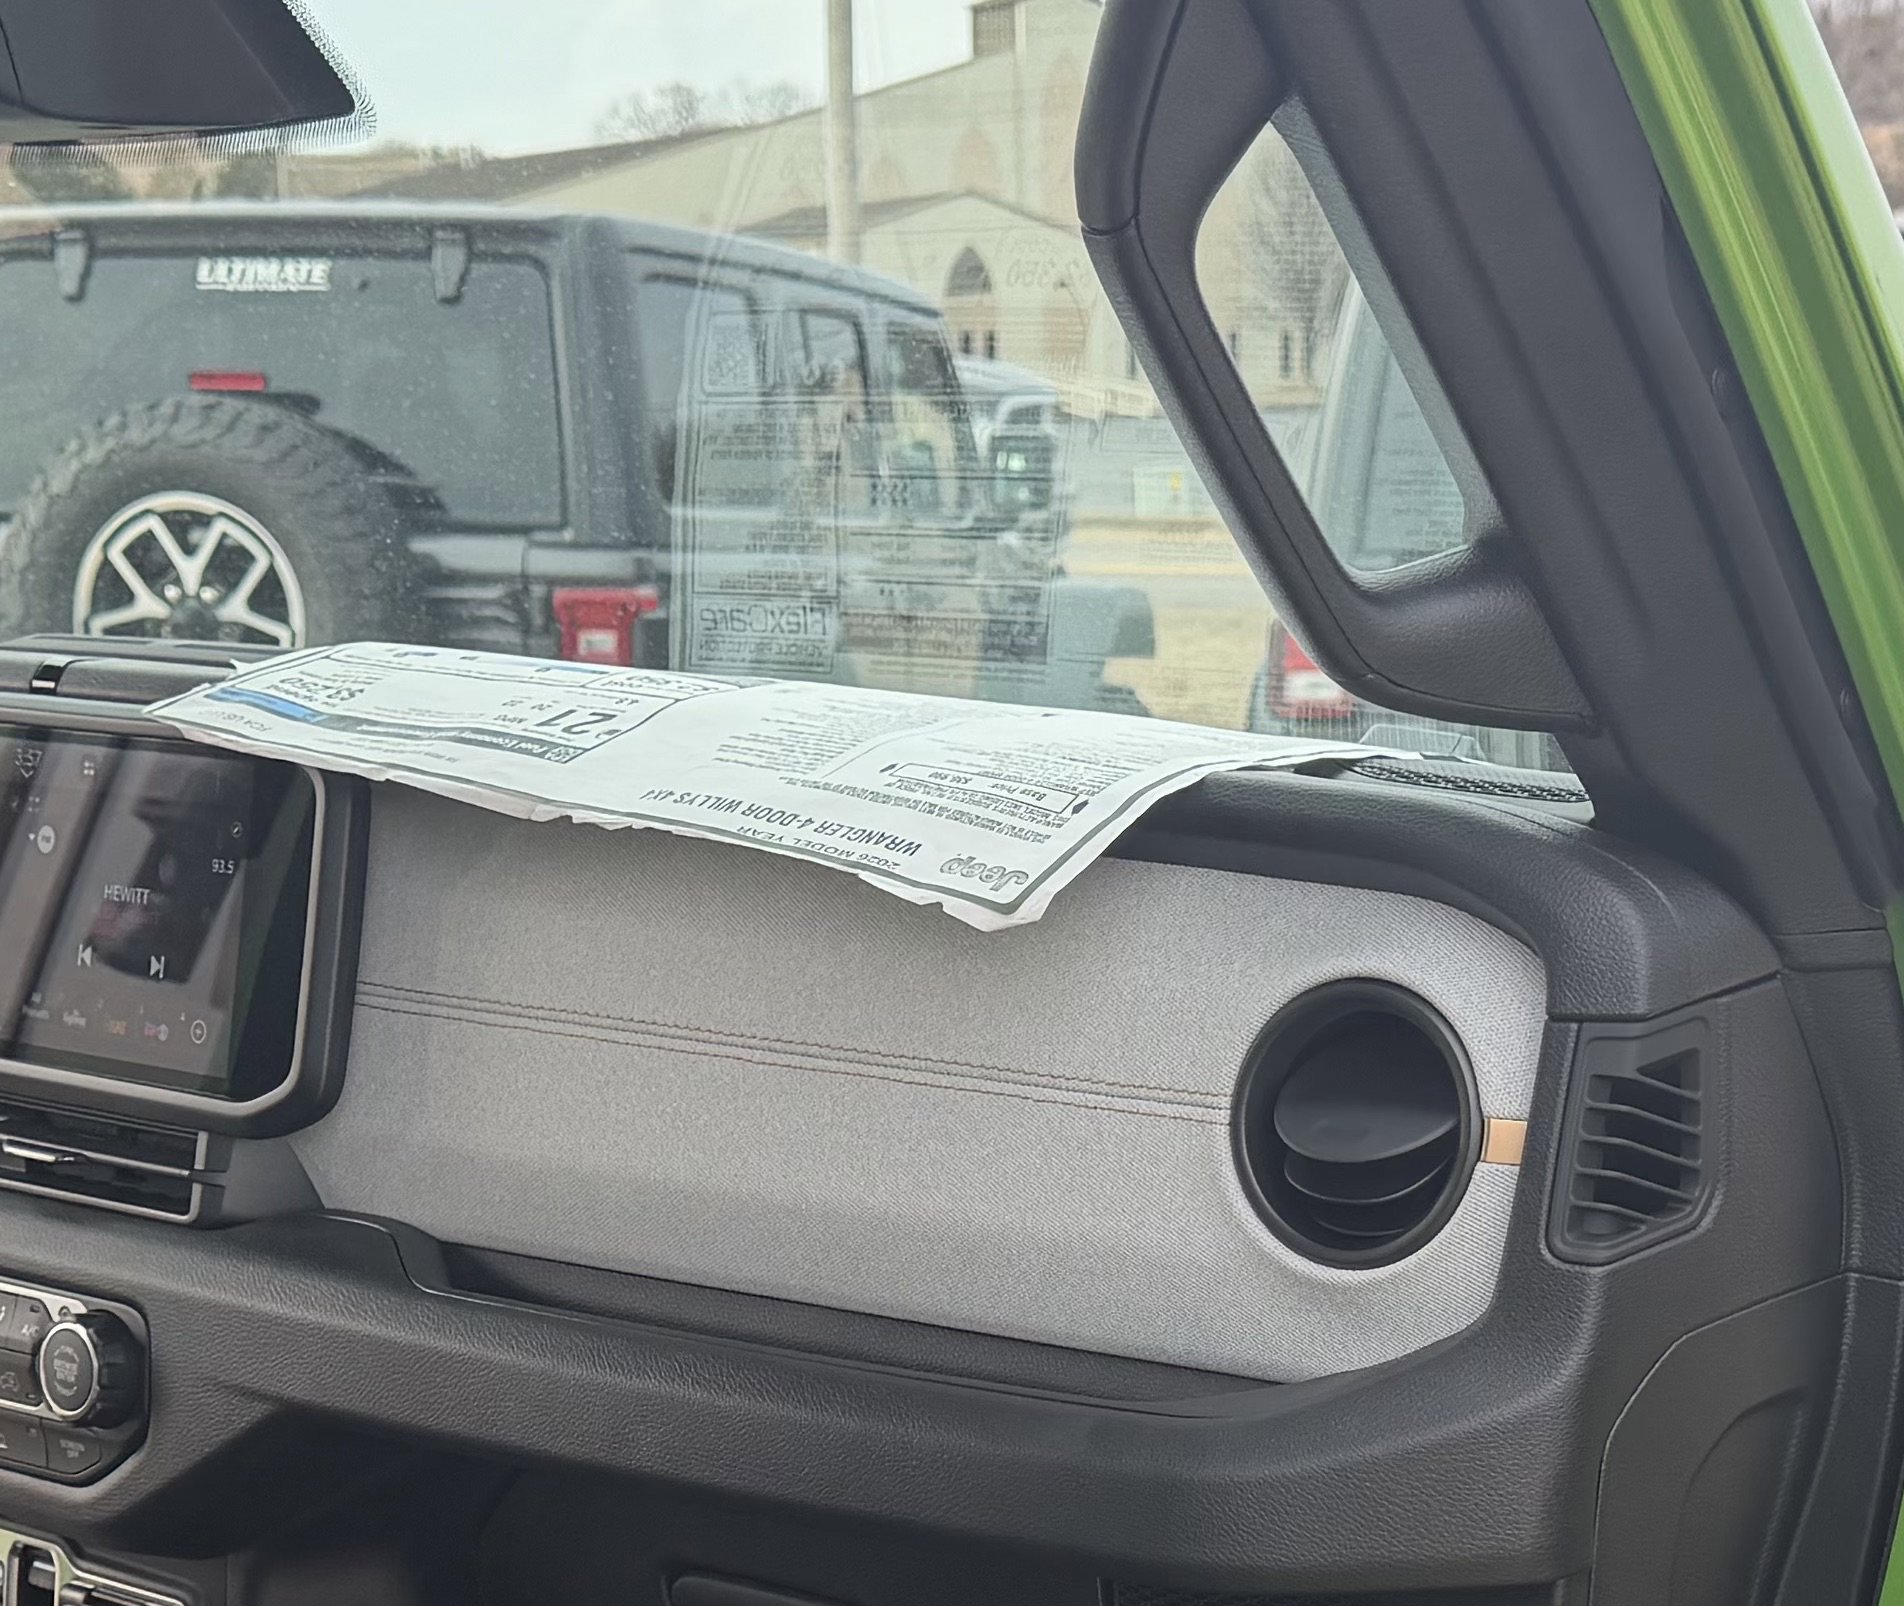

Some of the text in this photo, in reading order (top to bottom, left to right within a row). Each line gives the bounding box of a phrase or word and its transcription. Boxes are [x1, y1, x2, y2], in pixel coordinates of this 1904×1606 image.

[197, 256, 332, 284] ULTIMATE
[535, 710, 615, 735] 21
[672, 791, 744, 815] WILLYS
[1020, 789, 1047, 802] Base
[741, 802, 816, 829] 4-DOOR
[736, 825, 901, 870] 2026 MODEL YEAR
[813, 820, 923, 856] WRANGLER
[212, 858, 235, 874] 93.5
[939, 857, 1029, 892] Jeep
[104, 884, 151, 905] HEWITT
